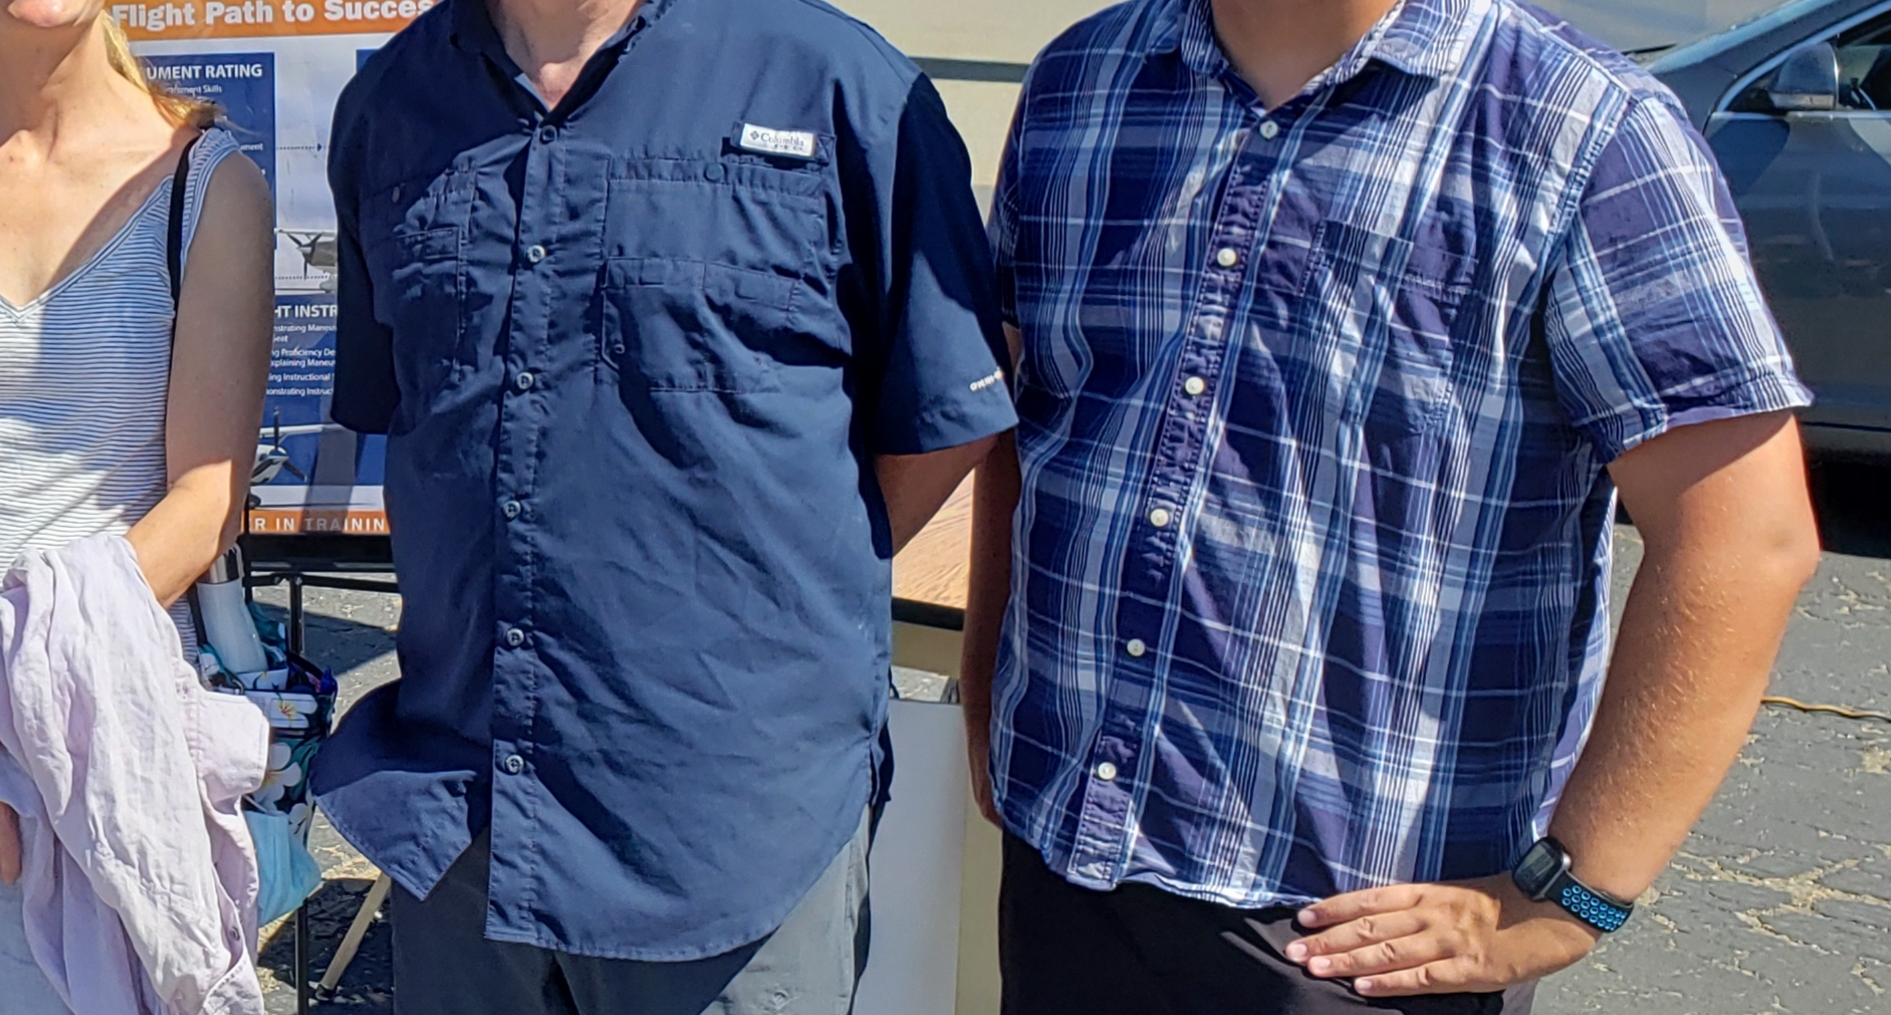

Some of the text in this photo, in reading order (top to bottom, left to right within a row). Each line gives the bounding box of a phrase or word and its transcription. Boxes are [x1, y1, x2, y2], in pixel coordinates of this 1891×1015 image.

[112, 1, 196, 32] Flight
[206, 0, 274, 24] Path
[146, 63, 264, 80] UMENT RATING
[760, 132, 805, 147] Columbia
[294, 305, 337, 319] INSTR
[274, 325, 306, 334] nstrating
[281, 347, 323, 358] Proficiency
[271, 359, 306, 368] xplaining
[283, 372, 331, 382] Instructional
[276, 518, 295, 531] IN
[305, 517, 385, 531] TRAININ
